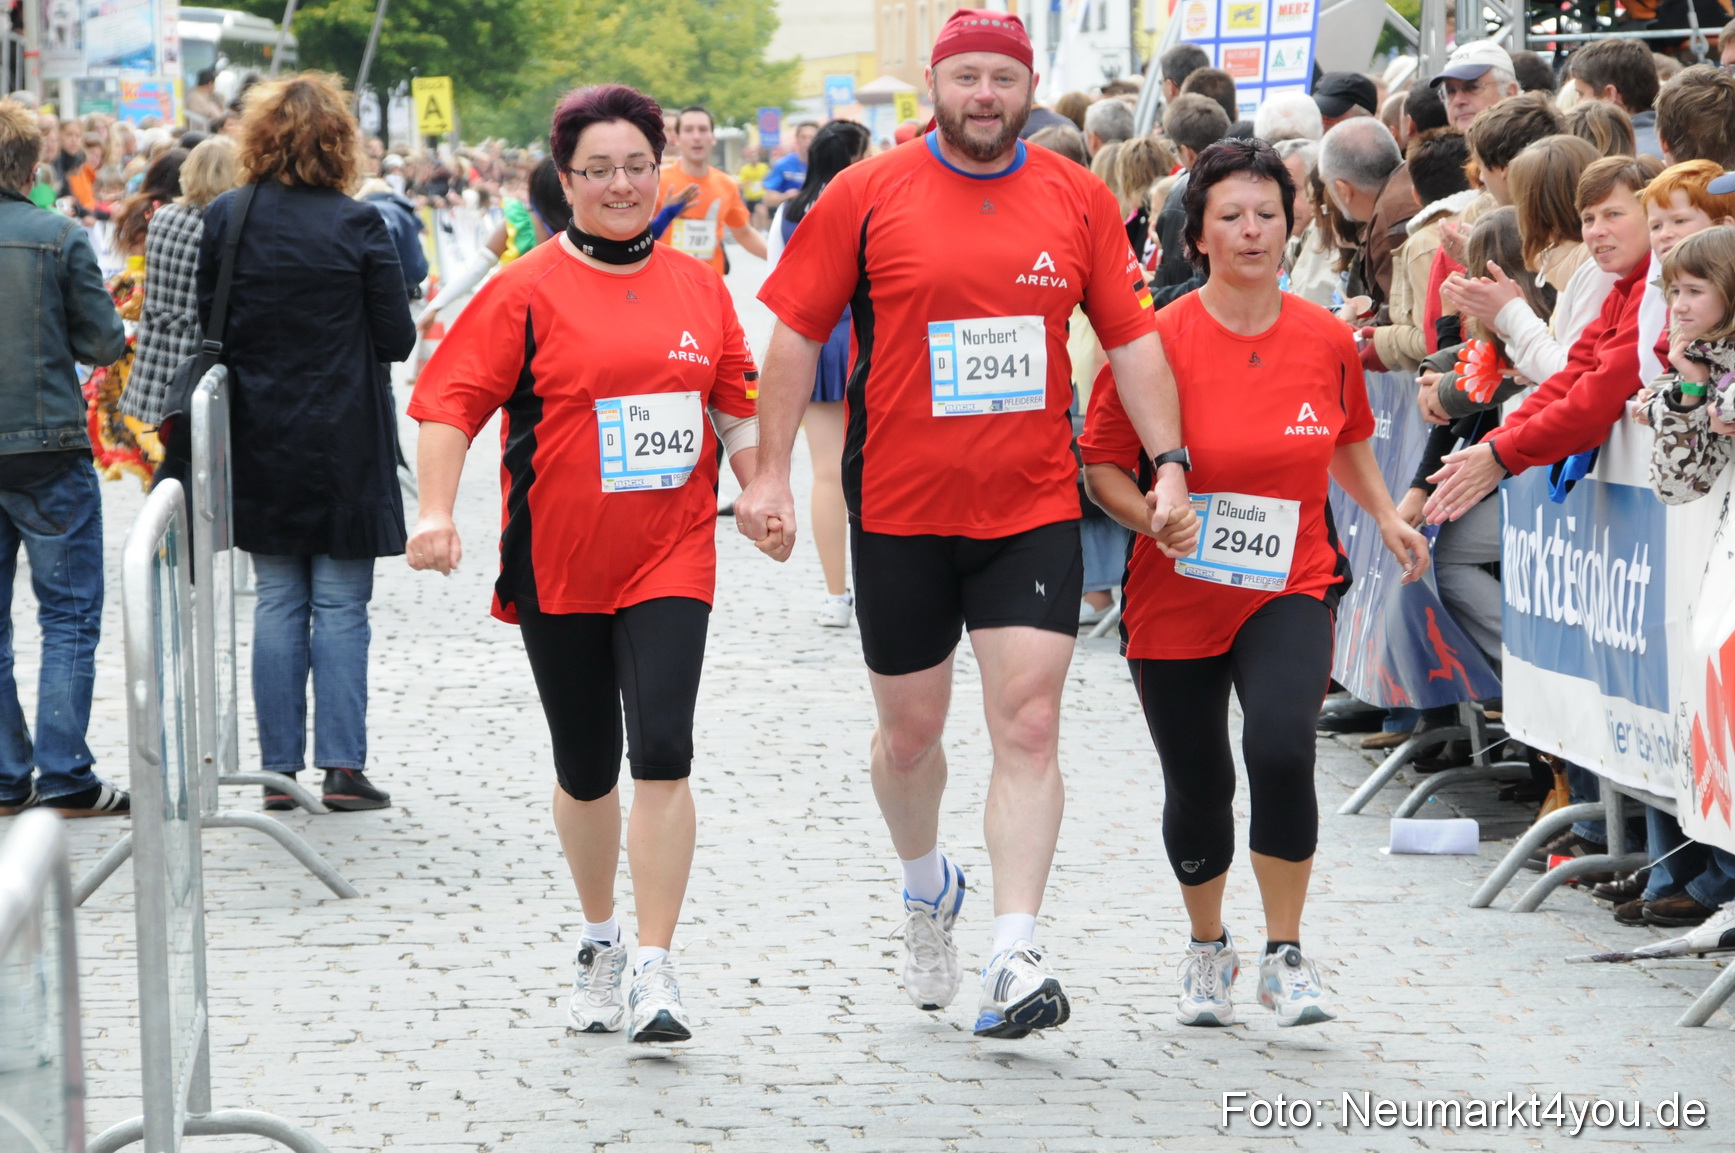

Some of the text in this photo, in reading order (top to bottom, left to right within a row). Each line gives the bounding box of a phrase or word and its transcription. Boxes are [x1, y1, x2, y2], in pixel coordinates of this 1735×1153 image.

[1278, 2, 1310, 16] MERZ
[423, 94, 444, 120] A
[688, 235, 709, 247] 787
[1015, 273, 1068, 289] AREVA
[962, 327, 1018, 346] Norbert
[668, 350, 710, 366] AREVA
[938, 357, 946, 370] D
[966, 353, 1030, 381] 2941
[1003, 395, 1044, 407] PFLEIDERER
[629, 405, 650, 422] Pia
[1284, 425, 1330, 436] AREVA
[606, 433, 614, 447] D
[633, 428, 695, 457] 2942
[1216, 499, 1267, 523] Claudia
[1211, 526, 1281, 558] 2940
[1244, 574, 1286, 586] PFLEIDERER
